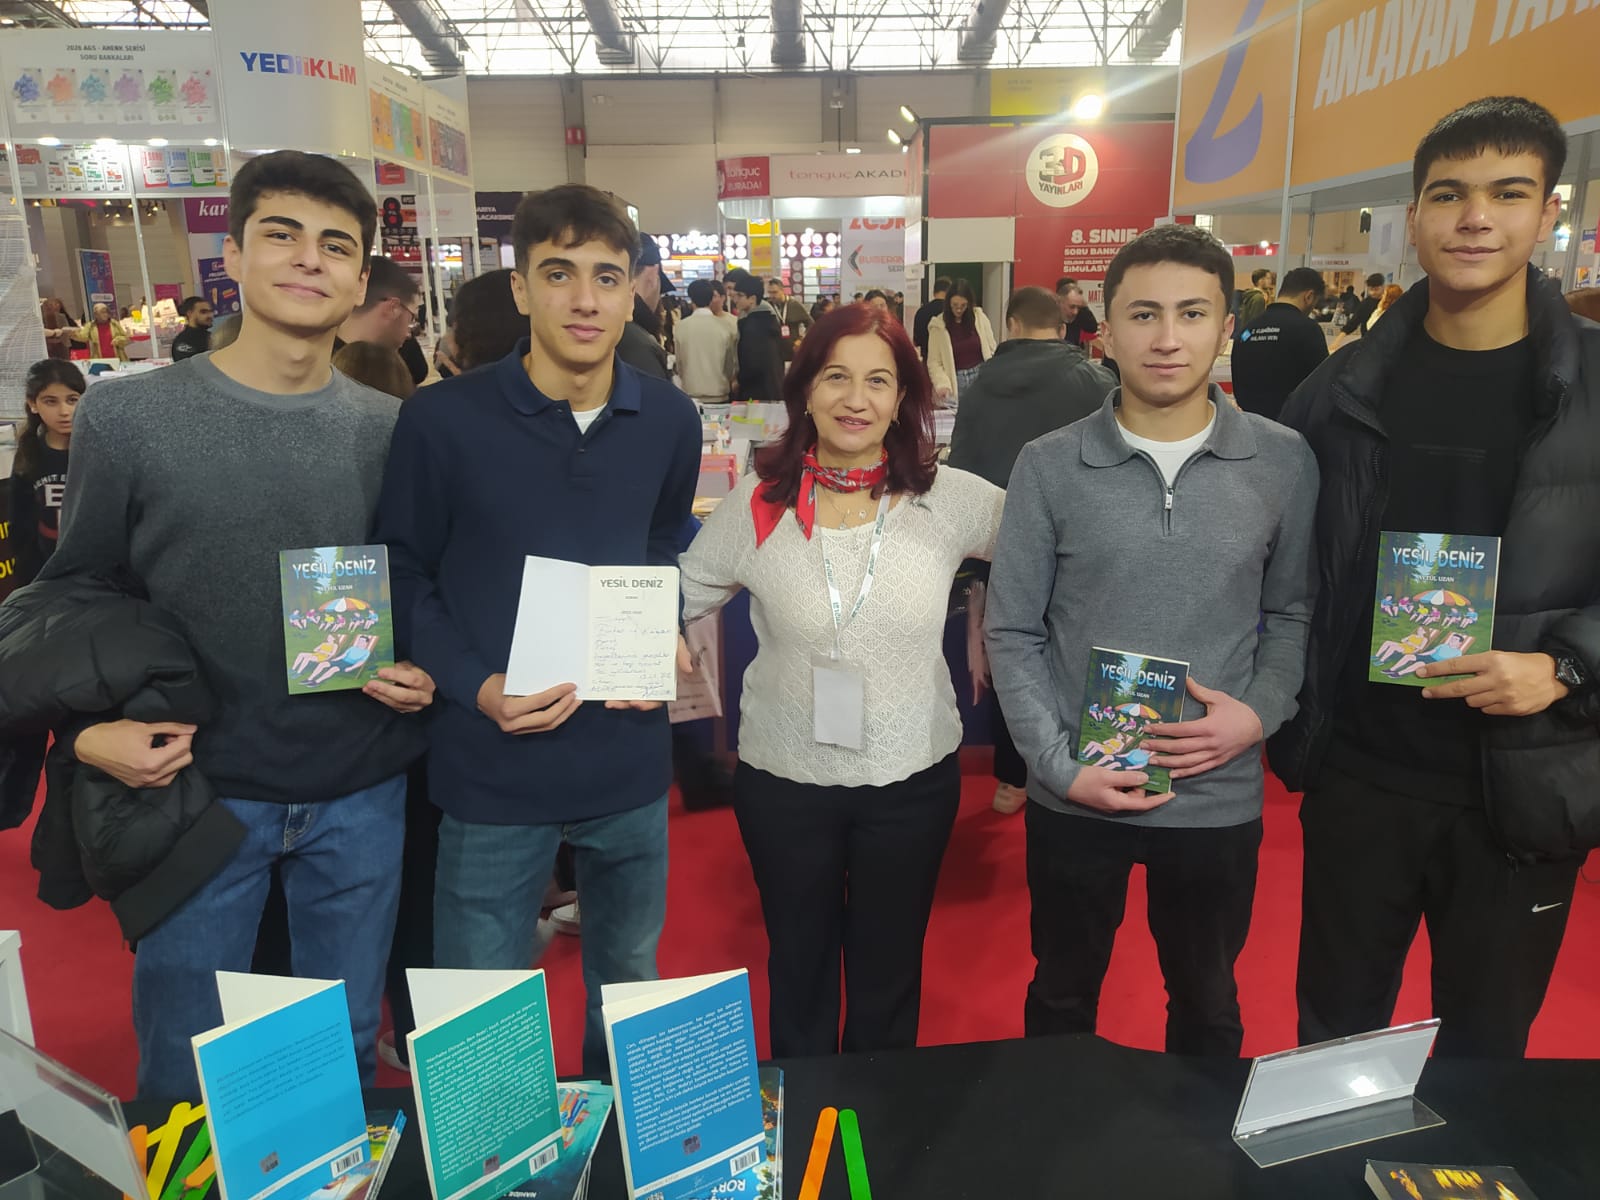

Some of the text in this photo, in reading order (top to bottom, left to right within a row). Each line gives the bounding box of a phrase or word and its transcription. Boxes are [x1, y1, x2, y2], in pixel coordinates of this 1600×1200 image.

[1313, 0, 1476, 110] ANLAYAN
[1038, 180, 1084, 195] YAYINLARI
[198, 200, 229, 217] kar
[1071, 228, 1139, 244] 8. SINIF
[1064, 247, 1089, 256] SORU
[335, 554, 377, 578] DENİZ
[1438, 545, 1486, 570] DENİZ
[631, 575, 664, 589] DENİZ
[1137, 670, 1177, 691] DENİZ
